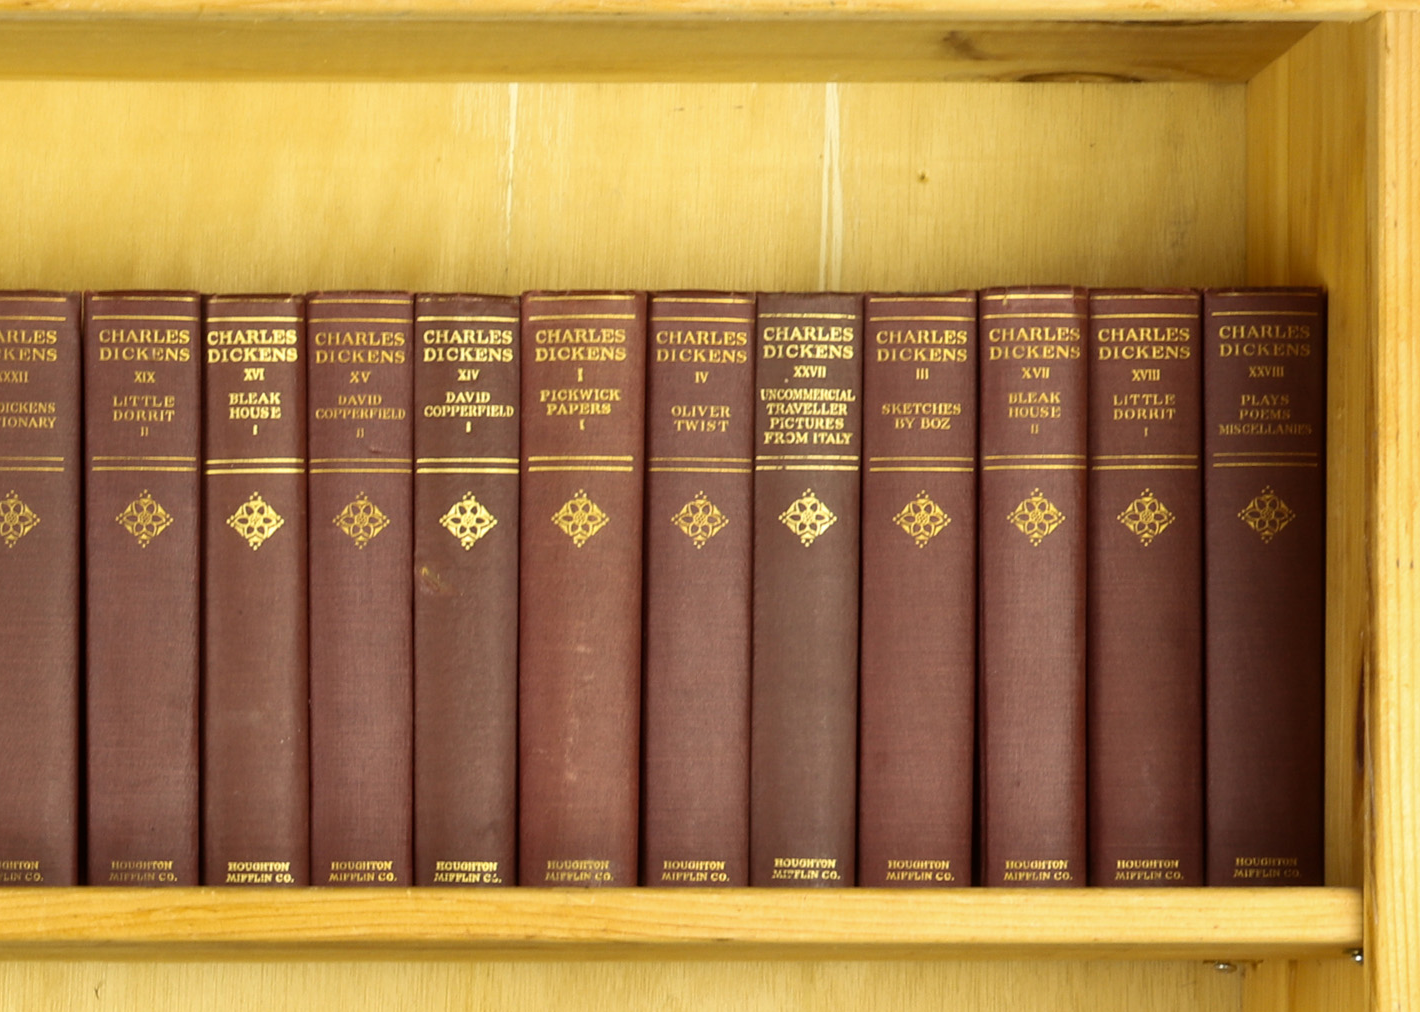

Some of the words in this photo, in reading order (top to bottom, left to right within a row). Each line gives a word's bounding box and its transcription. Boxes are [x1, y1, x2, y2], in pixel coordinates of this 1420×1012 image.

[99, 329, 190, 344] CHARLES
[207, 329, 297, 345] CHARLES
[535, 328, 626, 344] CHARLES
[763, 326, 854, 342] CHARLES
[989, 327, 1080, 342] CHARLES
[99, 346, 191, 362] DICKENS
[208, 348, 298, 363] DICKENS
[535, 347, 628, 362] DICKENS
[763, 344, 854, 359] DICKENS
[989, 345, 1080, 360] DICKENS
[243, 368, 265, 381] XVI
[793, 365, 827, 379] XXVII
[1131, 369, 1160, 381] XVIII
[228, 392, 281, 405] BLEAK
[445, 391, 491, 403] DAVID
[760, 388, 856, 402] UNCOMMERCIAL
[1113, 394, 1175, 406] LITTLE
[1241, 395, 1289, 406] PLAYS
[229, 406, 282, 419] HOUSE
[424, 405, 514, 417] COPPERFIELD
[671, 405, 732, 418] OLIVER
[766, 403, 848, 416] TRAVELLER
[881, 402, 961, 415] SKETCHES
[1113, 408, 1176, 420] DORRIT
[1240, 409, 1290, 420] POEMS
[673, 420, 729, 432] TWIST
[769, 417, 844, 430] PICTURES
[894, 417, 917, 430] BY
[921, 417, 951, 430] BOZ
[1218, 424, 1311, 435] MISCELLANIES
[763, 432, 808, 445] FROM
[812, 432, 853, 445] ITALY
[228, 861, 290, 872] HOUGHTON
[226, 873, 270, 884] MIFFLIN
